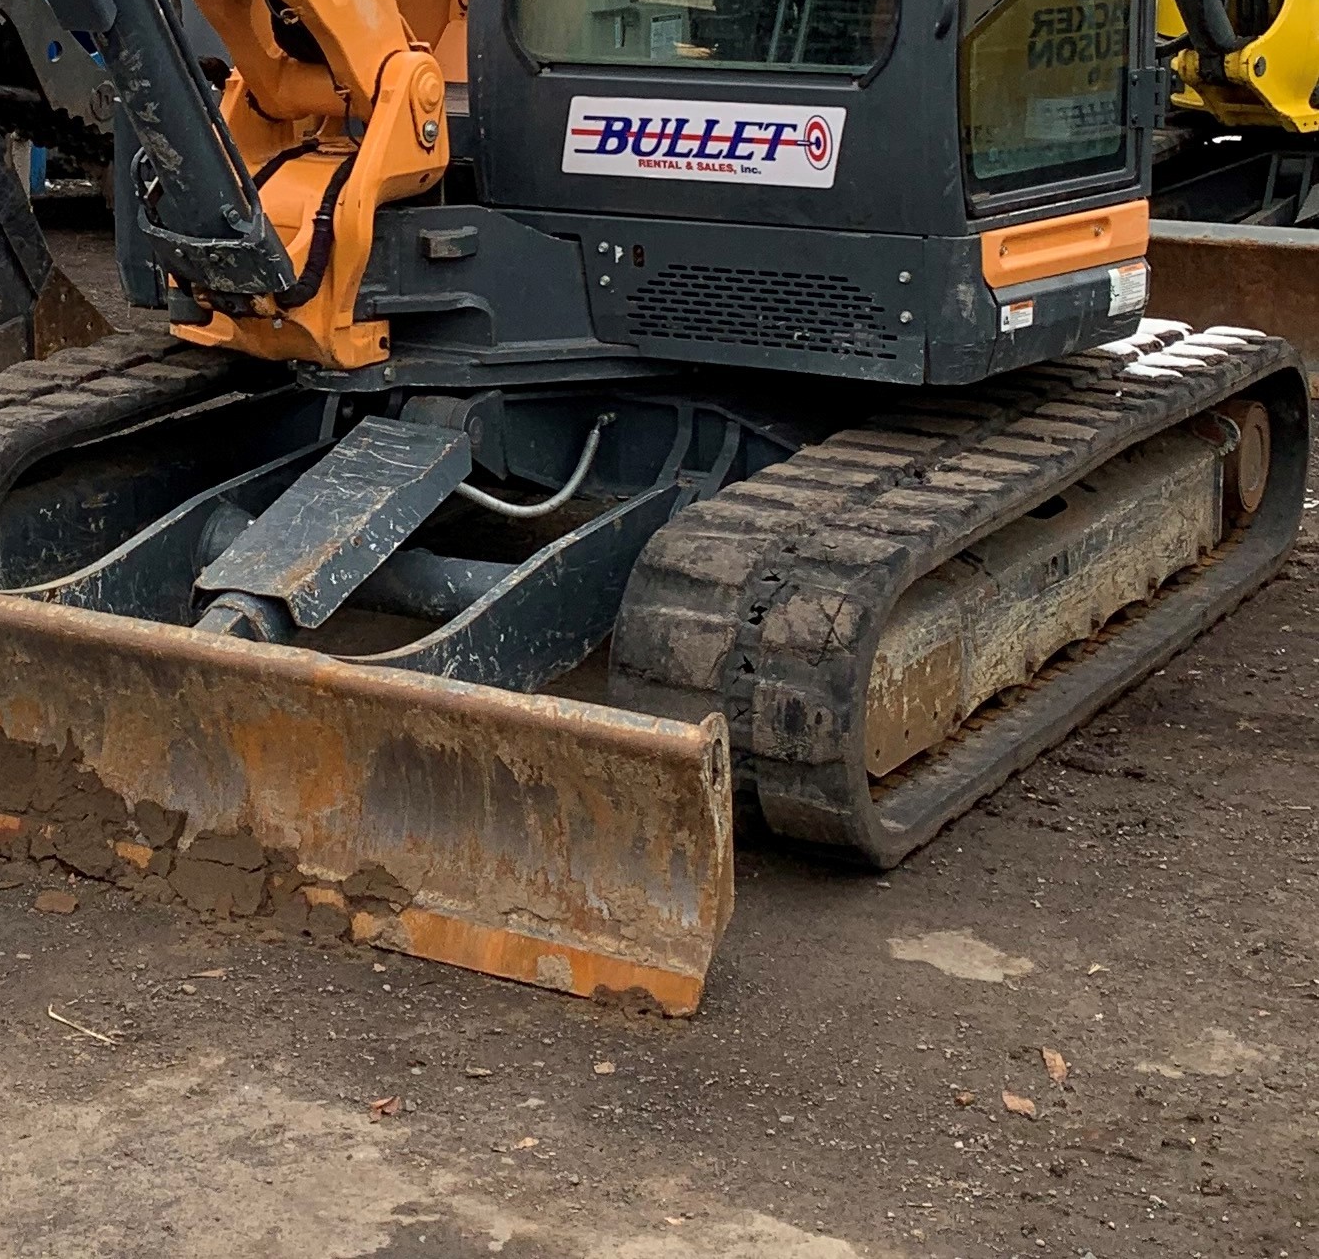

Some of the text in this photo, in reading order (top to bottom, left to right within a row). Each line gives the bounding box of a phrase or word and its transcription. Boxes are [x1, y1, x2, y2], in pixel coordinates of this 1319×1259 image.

[575, 114, 798, 162] BULLET
[638, 159, 682, 170] RENTAL
[685, 161, 693, 171] &
[696, 161, 738, 175] SALES,
